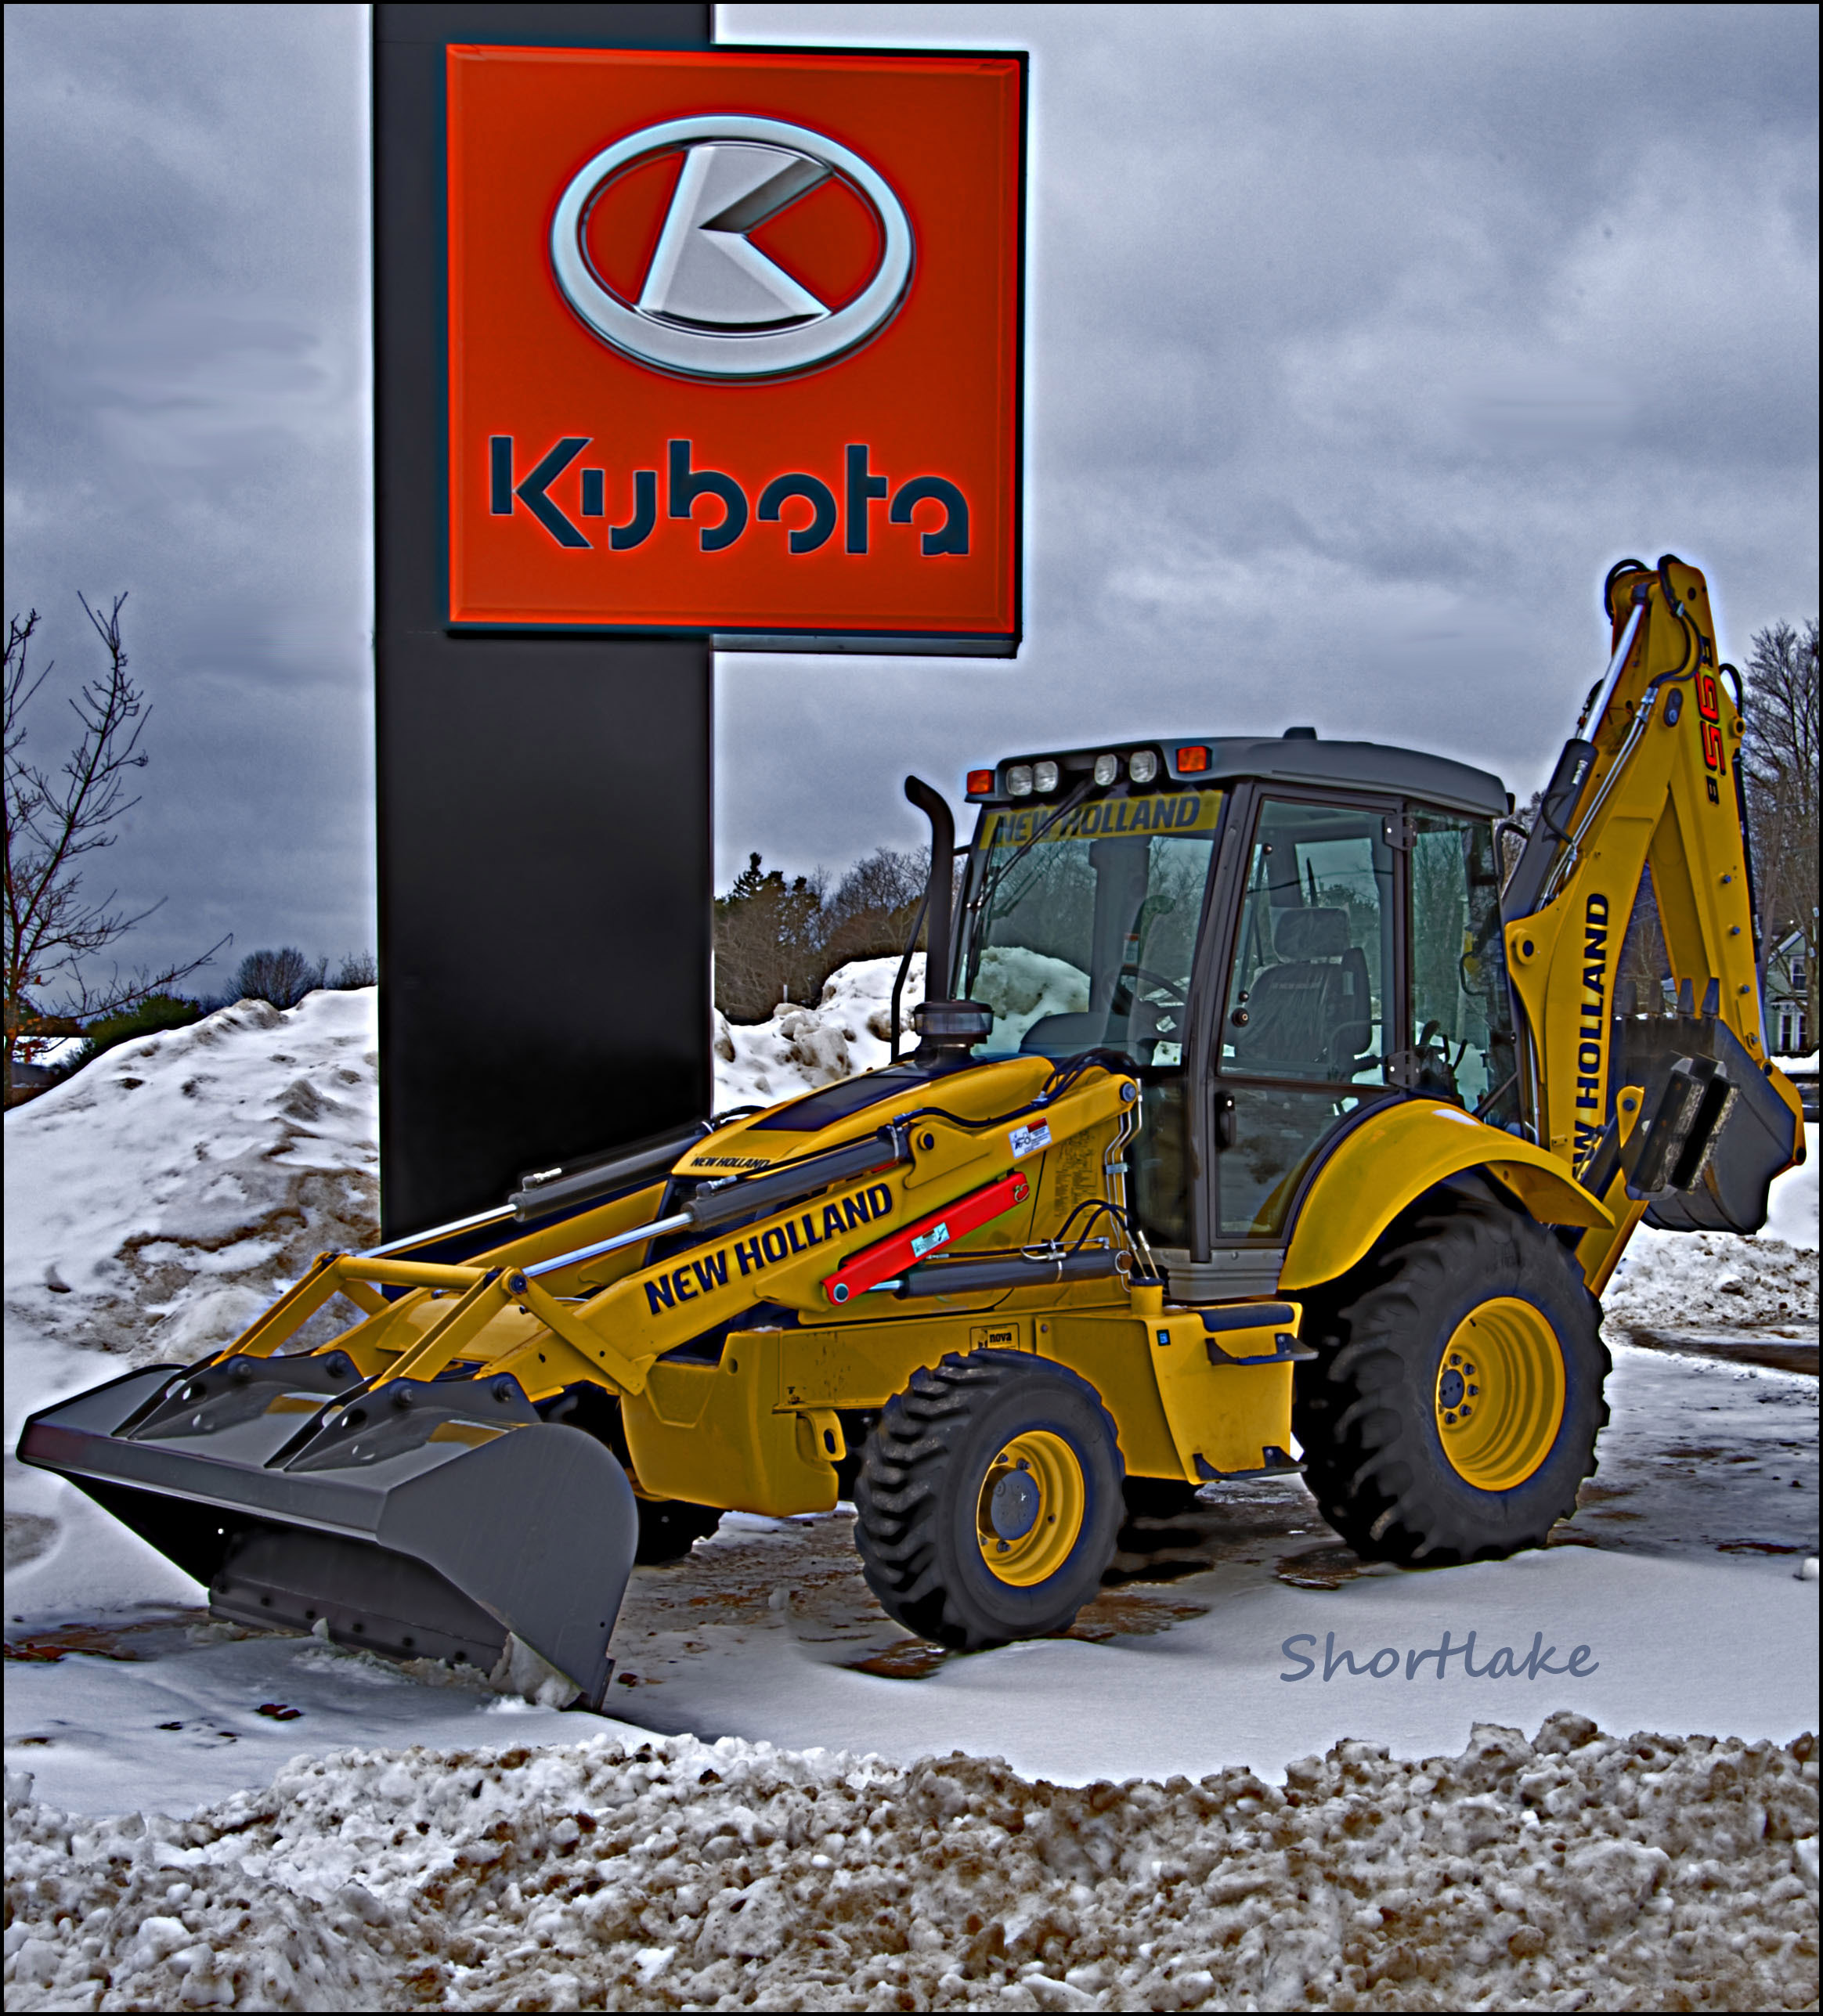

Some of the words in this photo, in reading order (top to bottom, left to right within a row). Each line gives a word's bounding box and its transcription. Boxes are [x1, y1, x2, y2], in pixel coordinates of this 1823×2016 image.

[489, 435, 970, 557] Kubota
[995, 808, 1059, 843] NEW
[1060, 795, 1200, 836] HOLLAND
[1576, 893, 1609, 1109] HOLLAND
[691, 1156, 719, 1167] NEW
[717, 1157, 771, 1169] HOLLAND
[644, 1250, 729, 1316] NEW
[735, 1182, 893, 1277] HOLLAND
[989, 1332, 1013, 1343] nova
